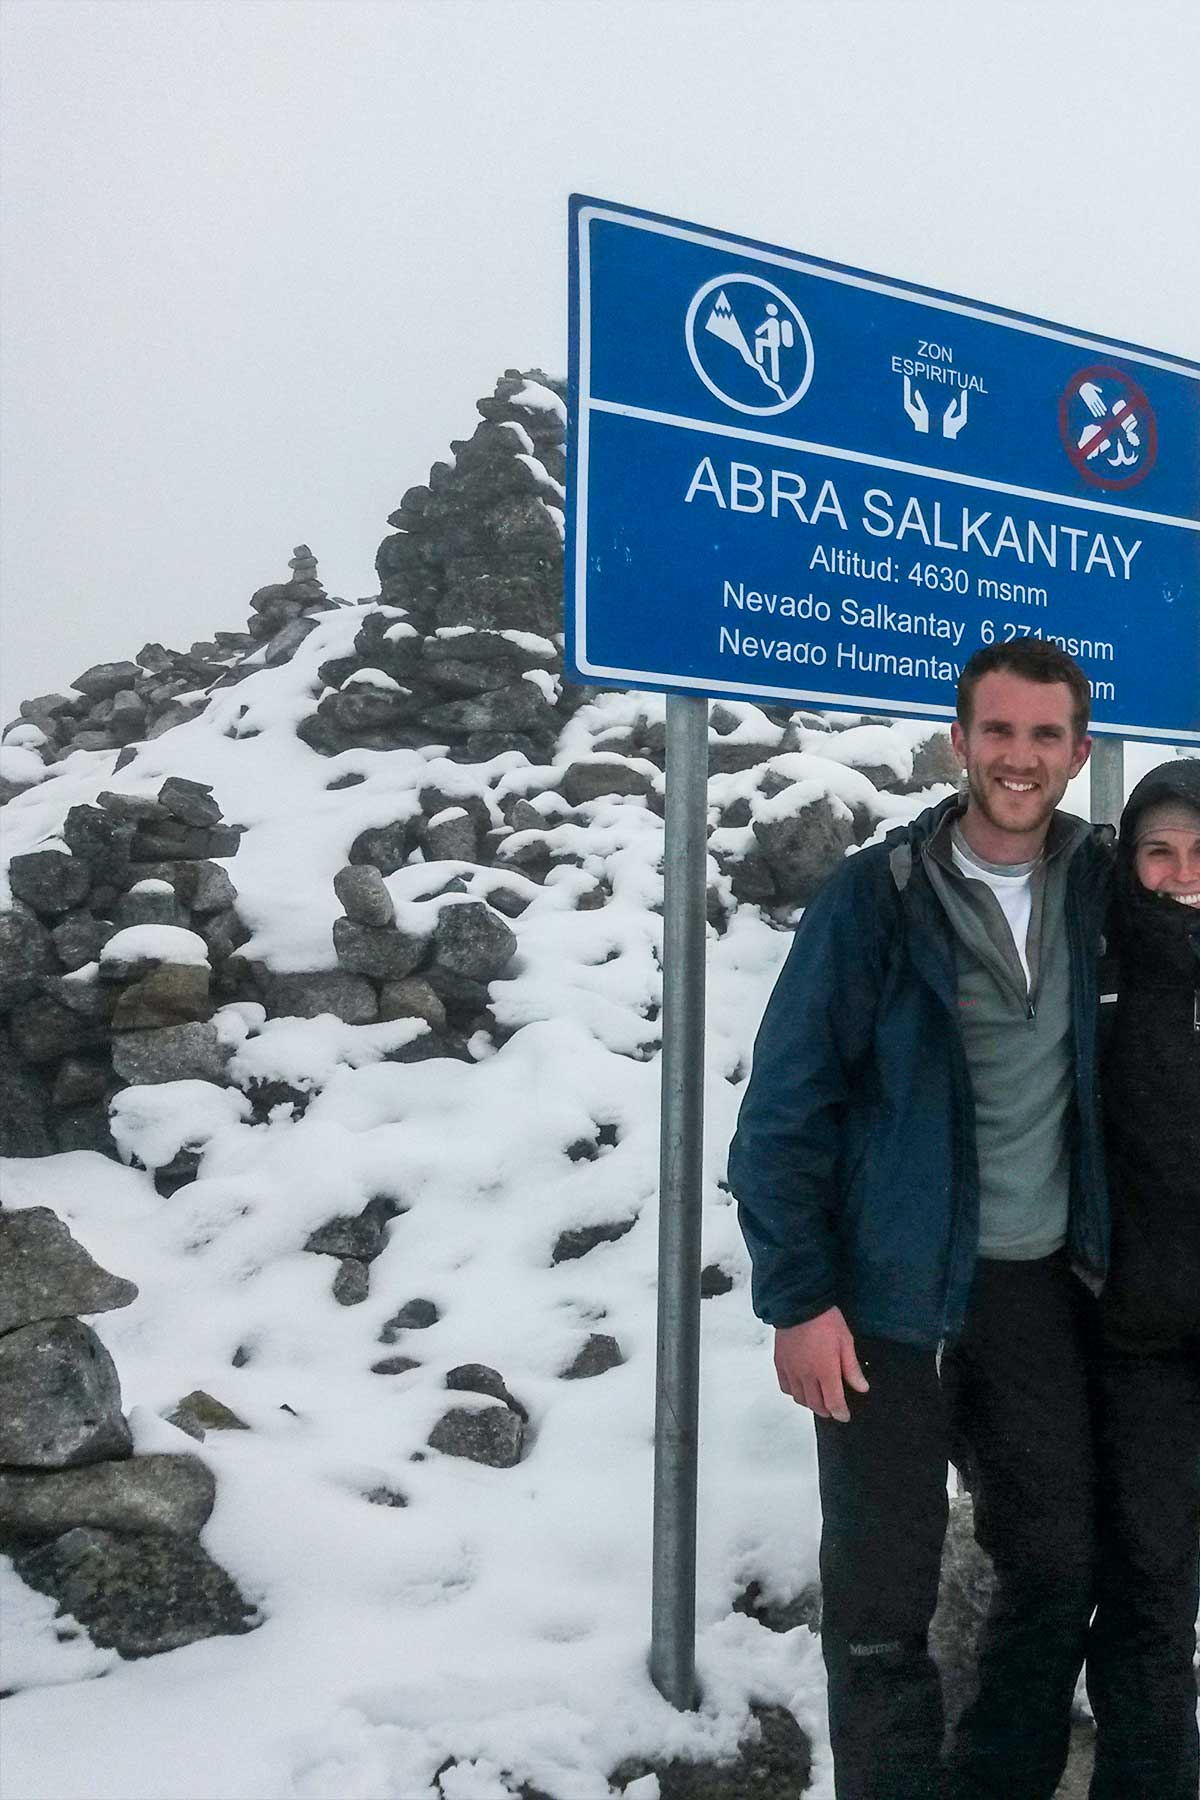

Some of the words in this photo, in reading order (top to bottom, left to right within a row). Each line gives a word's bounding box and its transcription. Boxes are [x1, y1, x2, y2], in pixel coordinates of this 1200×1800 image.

[891, 355, 989, 394] ESPIRITUAL
[917, 340, 953, 363] ZON
[685, 456, 848, 531] ABRA
[862, 488, 1144, 580] SALKANTAY
[809, 545, 900, 584] Altitud:
[908, 562, 969, 594] 4630
[977, 578, 1048, 607] msnm
[723, 581, 831, 623] Nevado
[840, 598, 966, 646] Salkantay
[719, 626, 828, 667] Nevado
